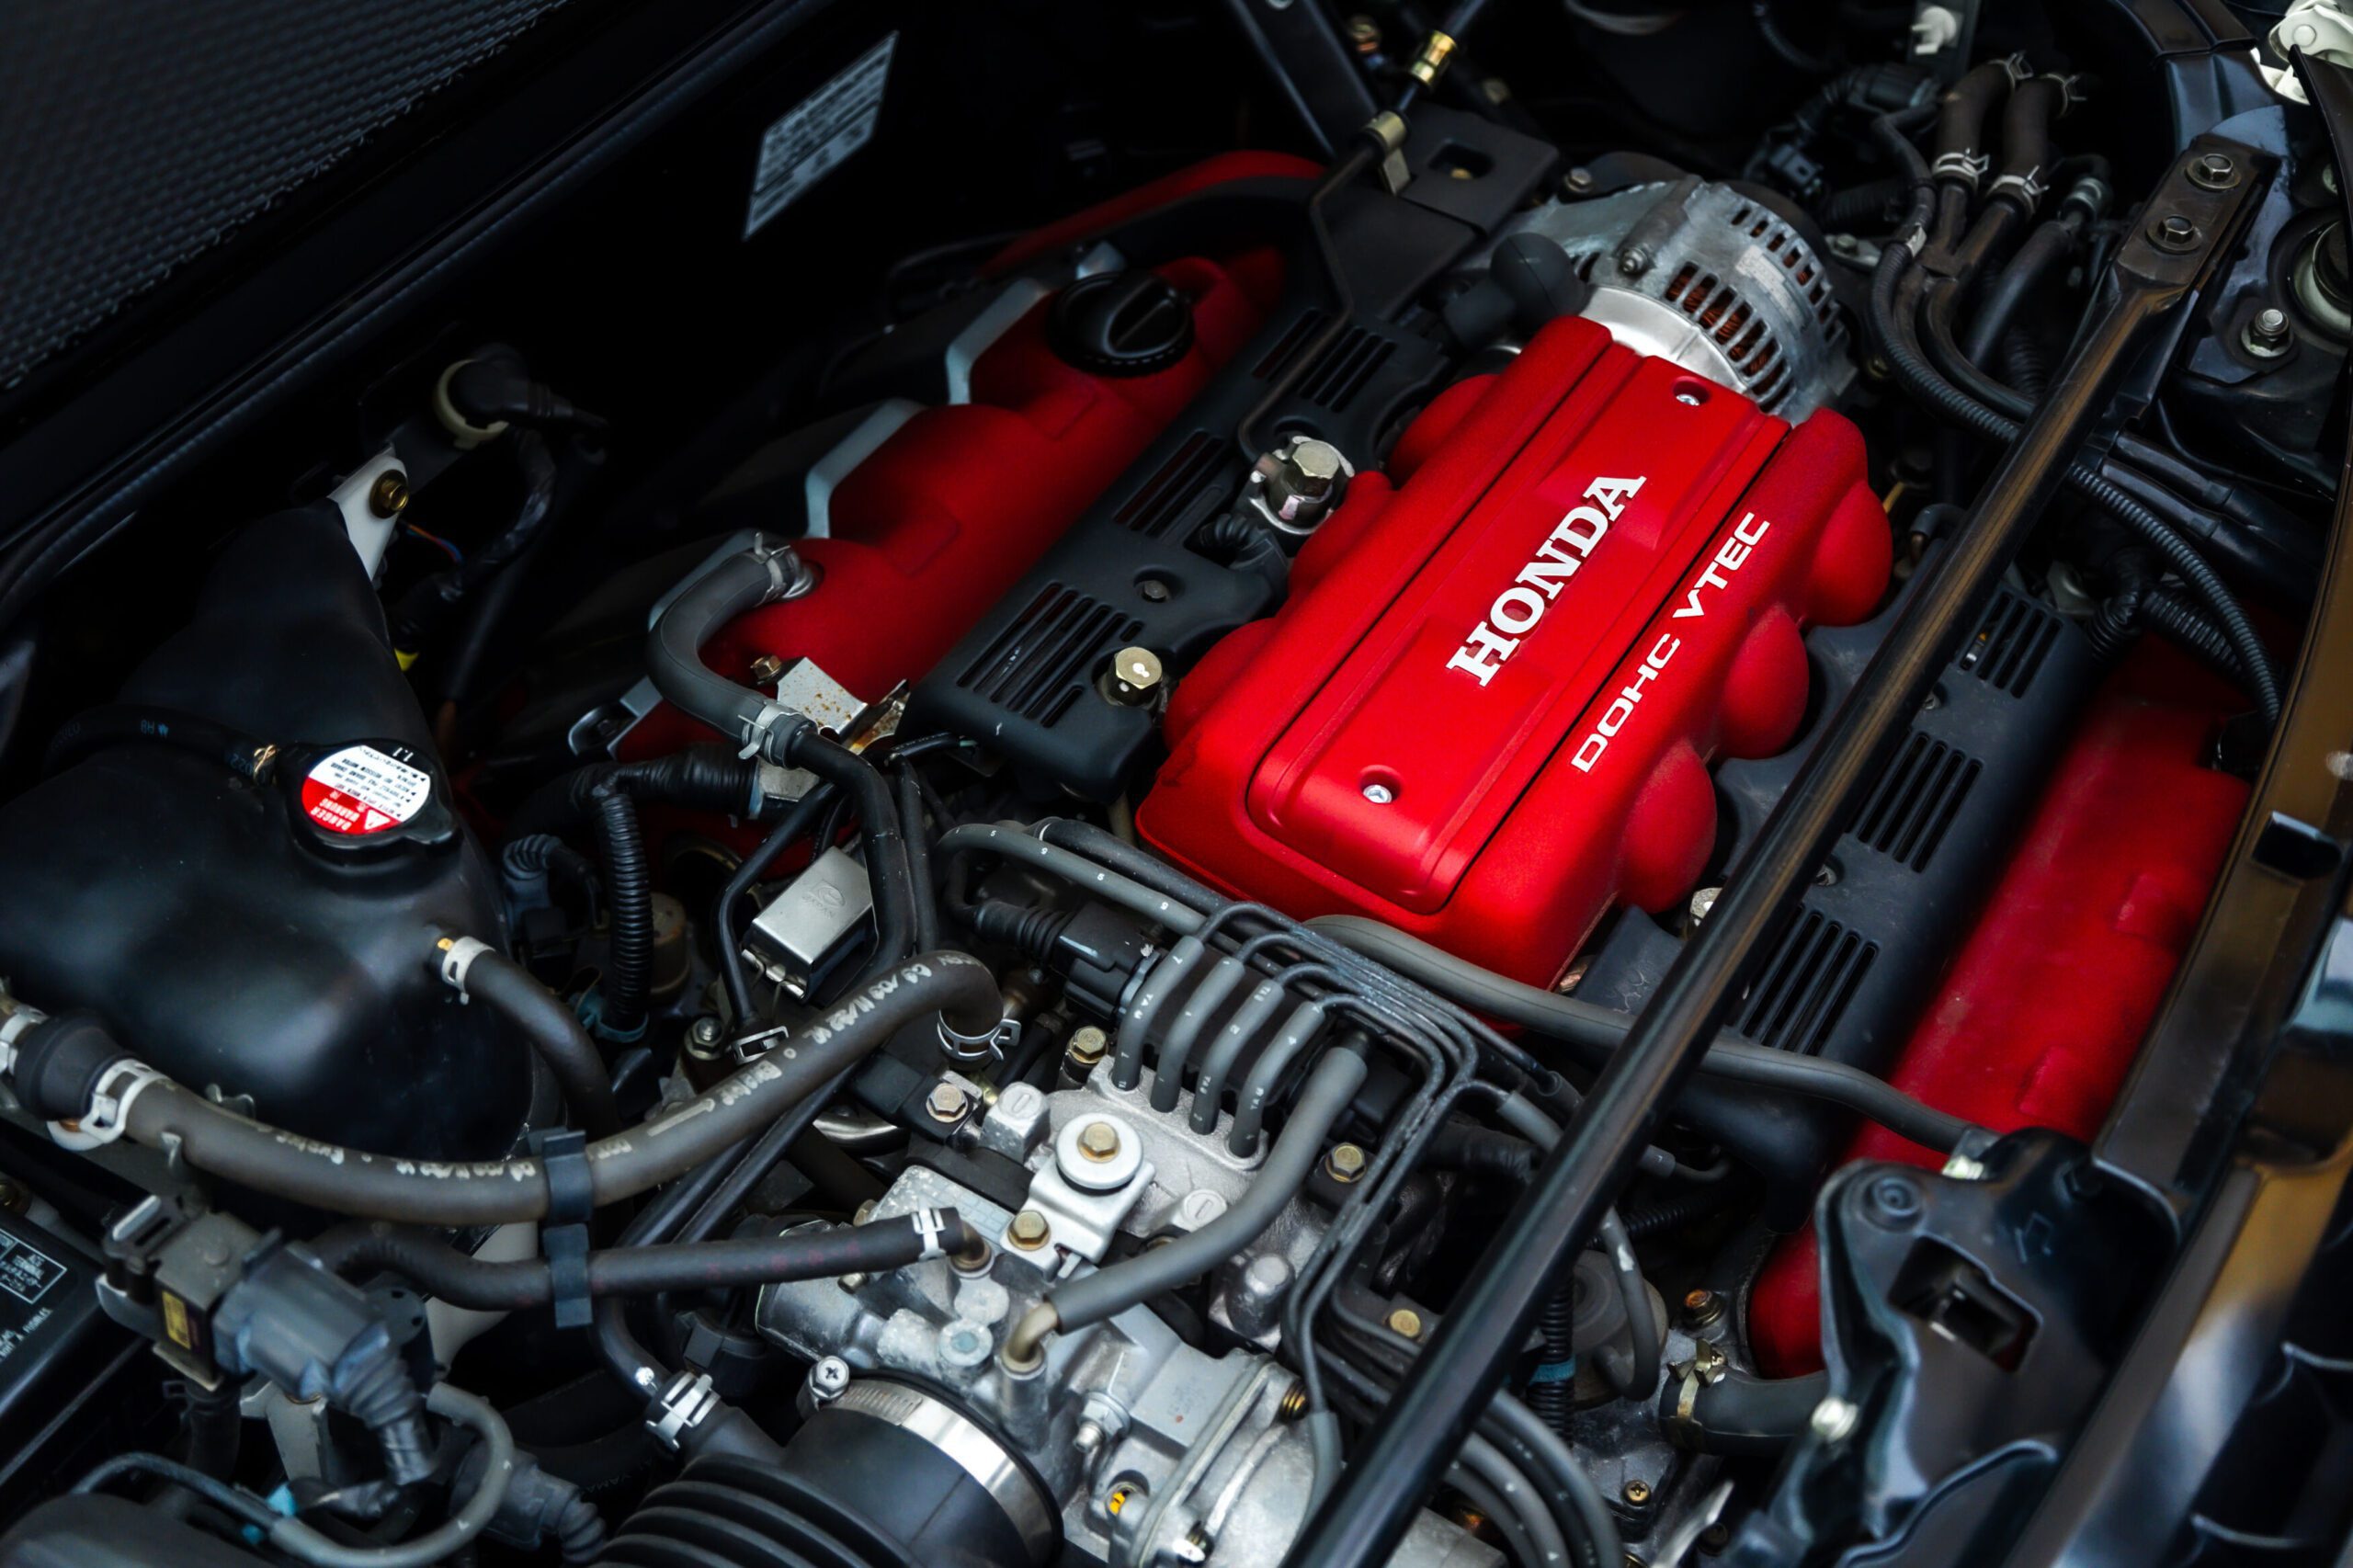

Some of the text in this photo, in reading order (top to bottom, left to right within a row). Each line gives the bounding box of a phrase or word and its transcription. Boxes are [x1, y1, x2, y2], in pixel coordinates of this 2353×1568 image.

[1445, 476, 1646, 687] HONDA
[1571, 512, 1770, 773] DOHC VTEC
[310, 806, 352, 831] DANGER
